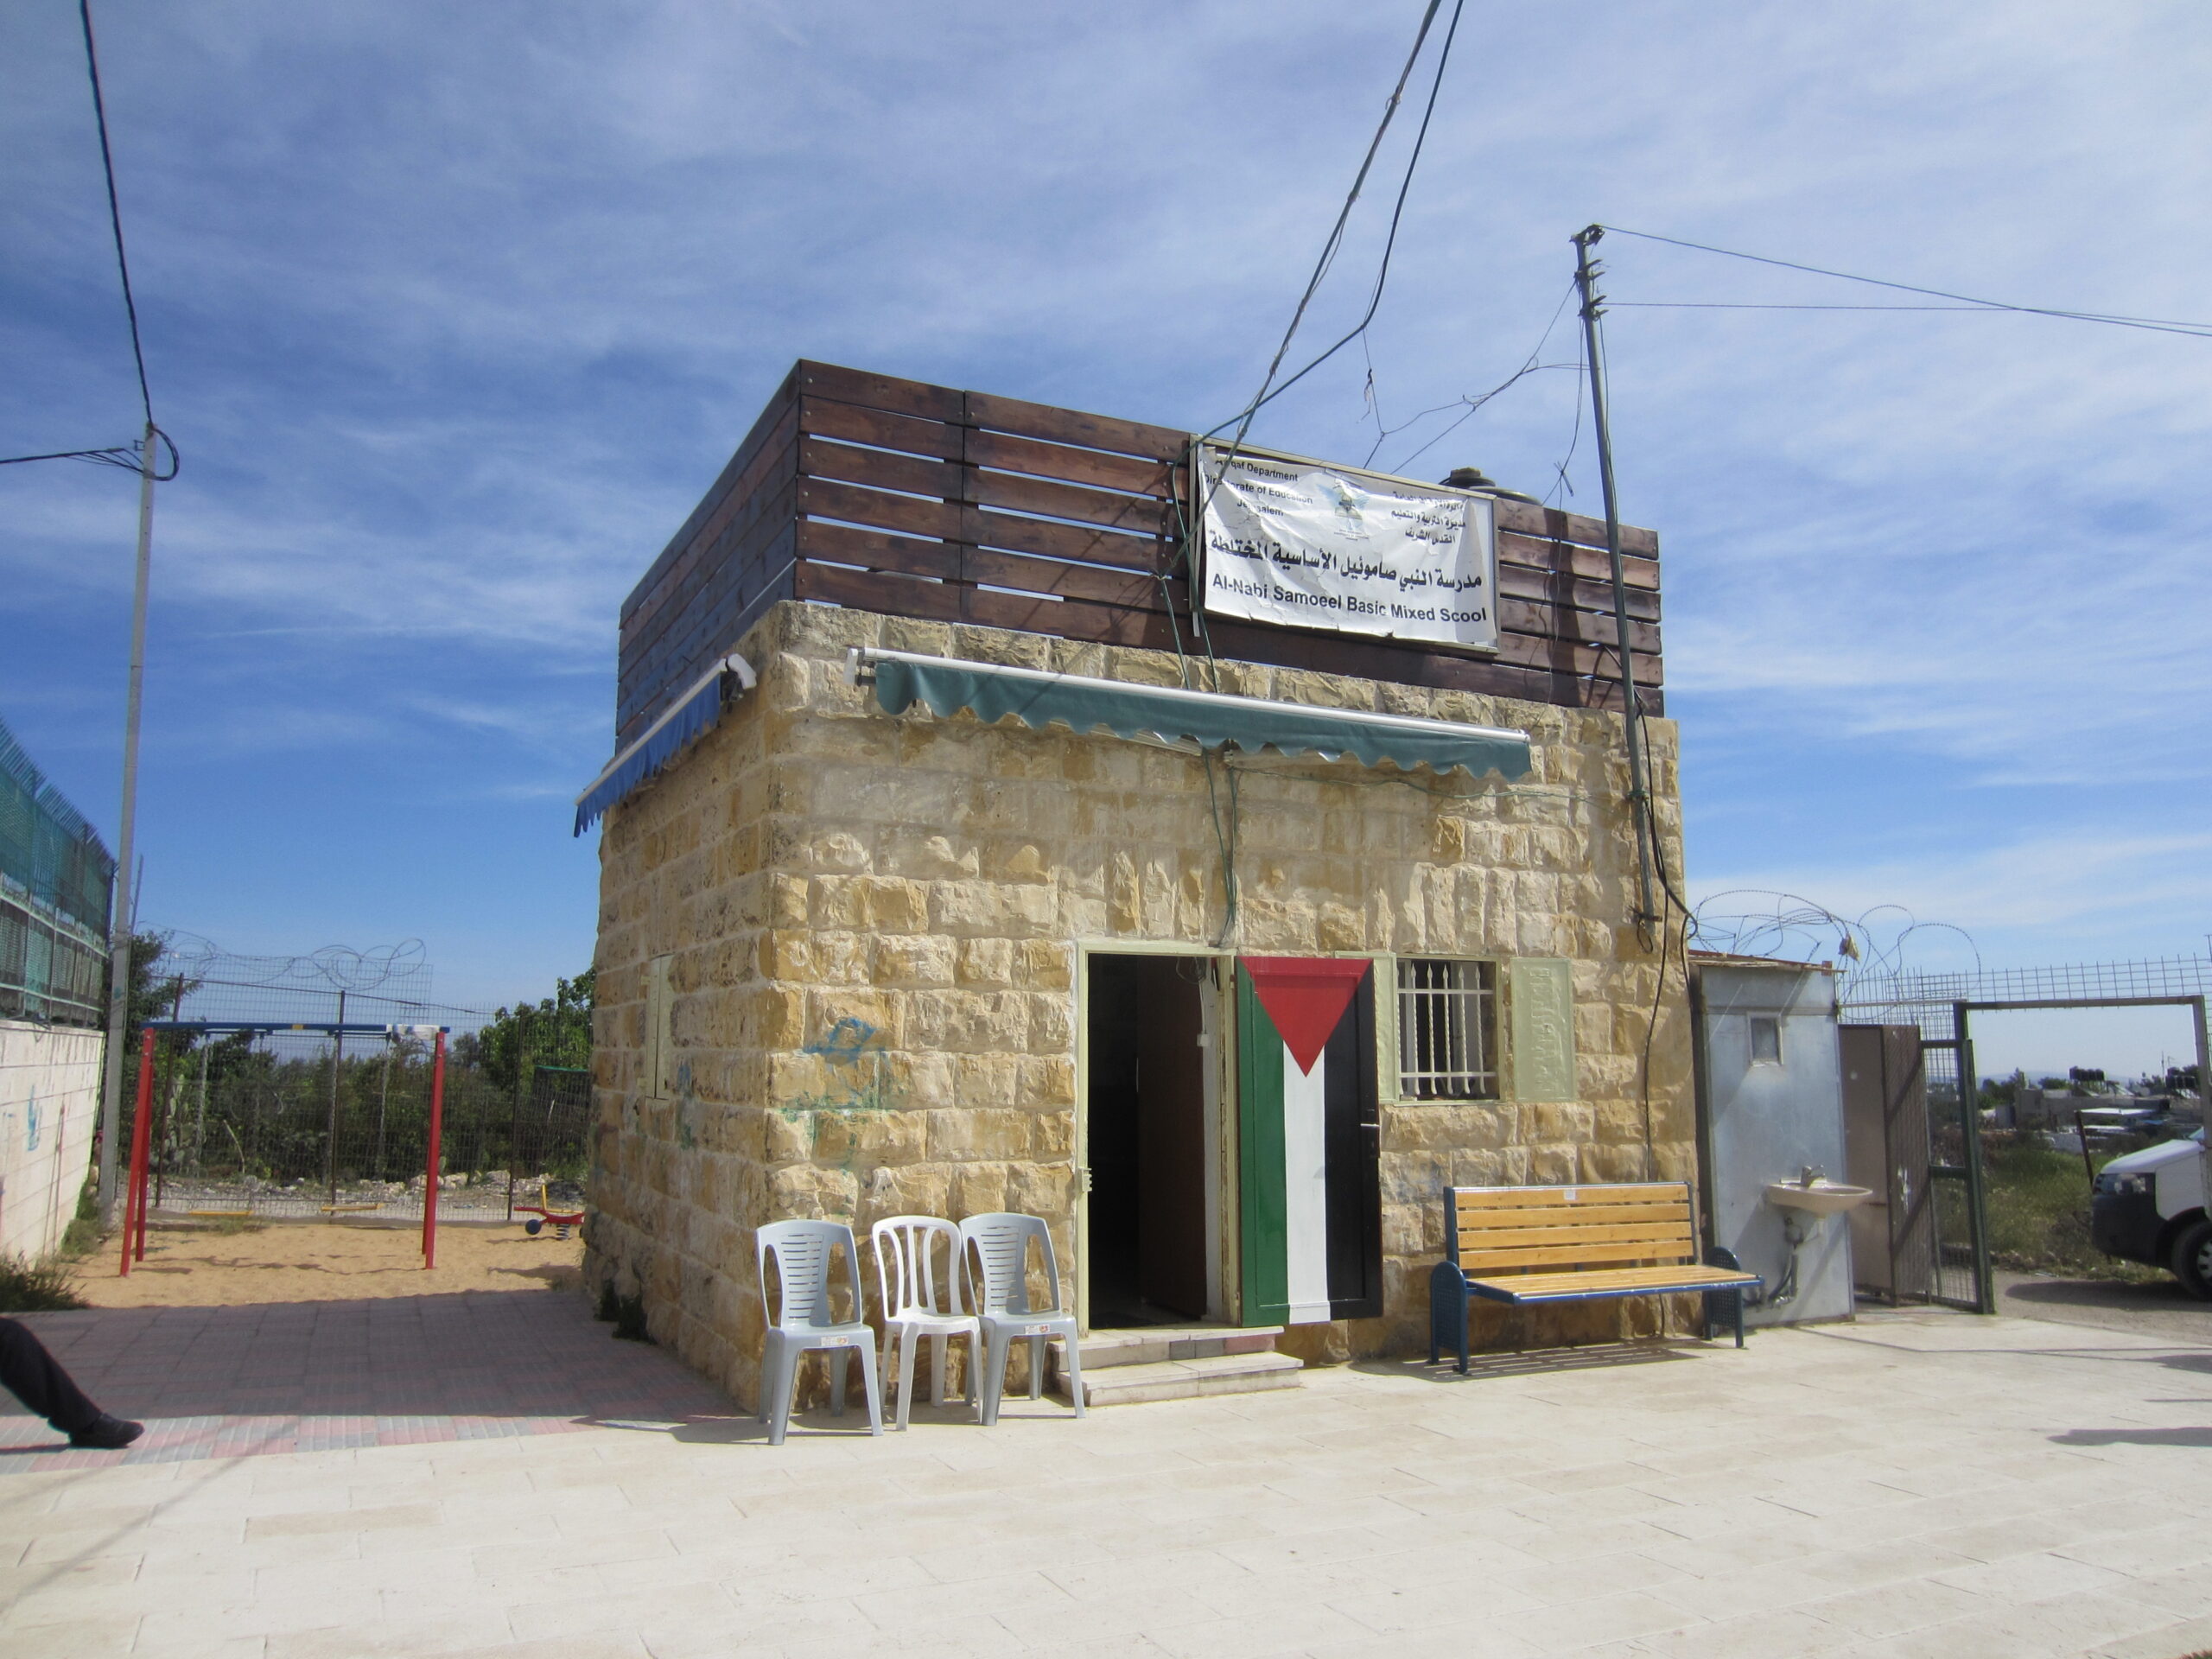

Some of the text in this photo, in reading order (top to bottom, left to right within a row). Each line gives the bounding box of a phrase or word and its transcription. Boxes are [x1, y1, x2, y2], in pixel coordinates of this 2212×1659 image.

[1247, 463, 1299, 481] Department
[1257, 486, 1267, 494] of
[1391, 510, 1421, 524] والتعليم
[1421, 512, 1443, 527] التربية
[1405, 527, 1456, 545] القدس الشريف
[1273, 541, 1337, 569] الأساسية
[1340, 554, 1397, 581] صاموئيل
[1399, 568, 1433, 593] النبي
[1434, 568, 1483, 593] مدرسة
[1212, 573, 1487, 623] Al-Nabi Samoeel Basic Mixed Scool
